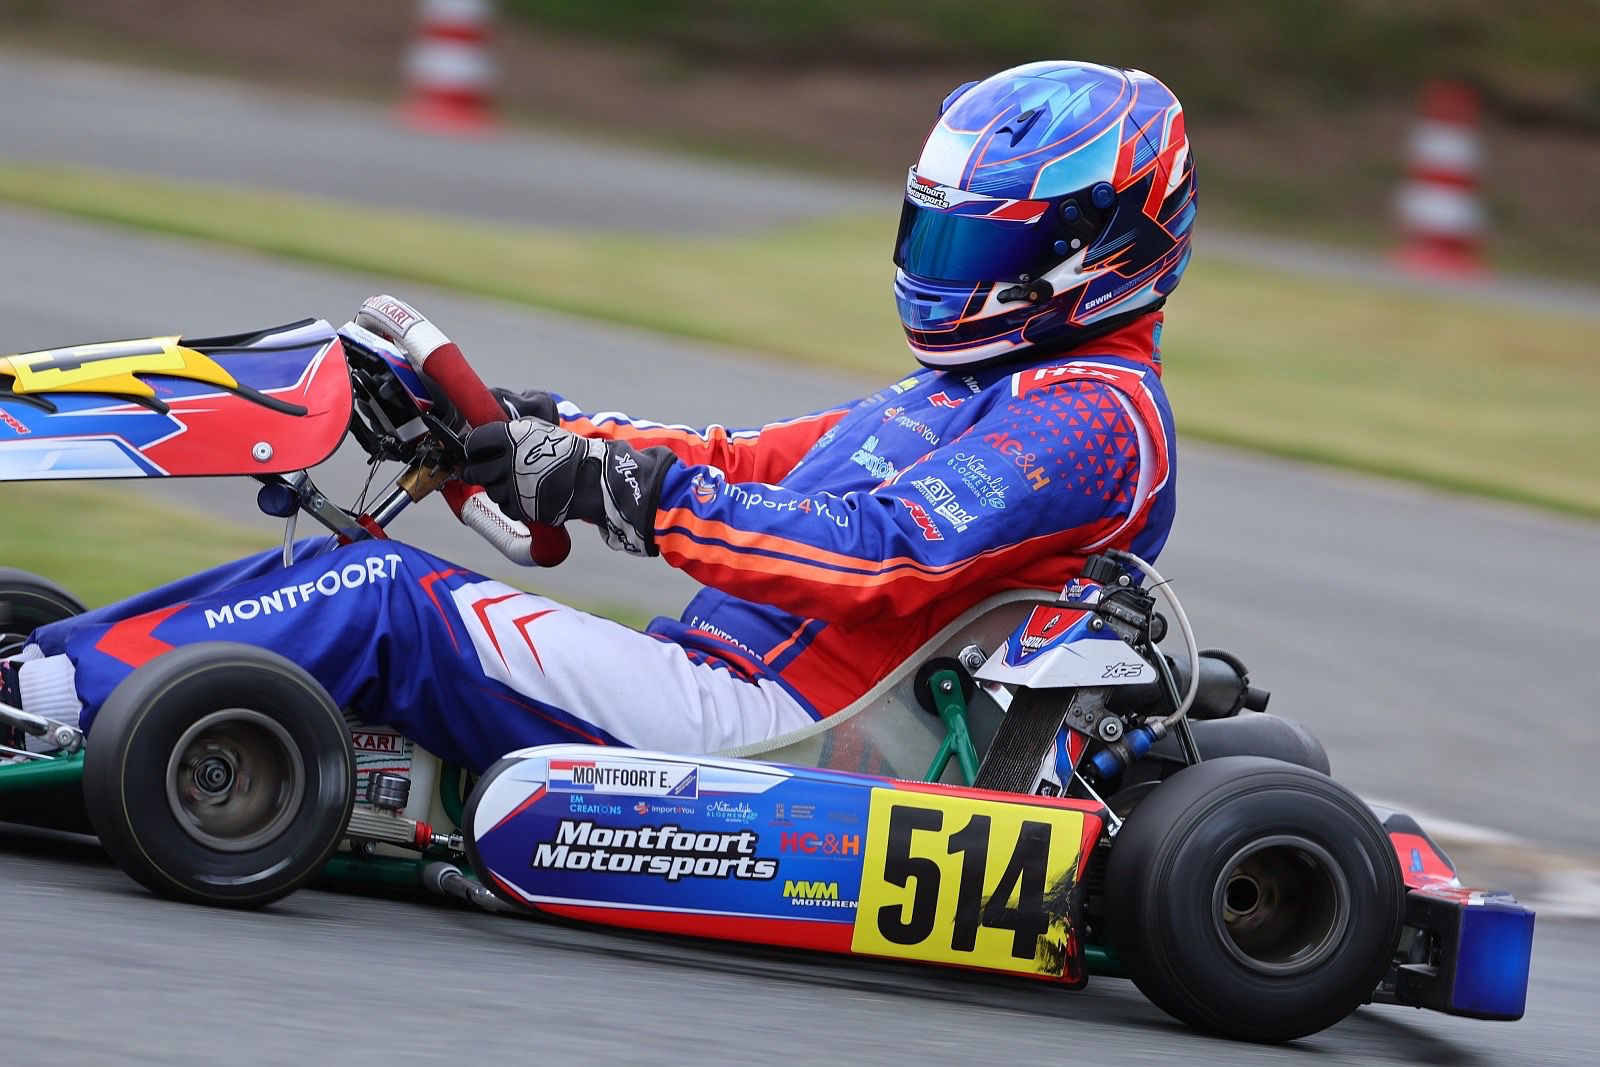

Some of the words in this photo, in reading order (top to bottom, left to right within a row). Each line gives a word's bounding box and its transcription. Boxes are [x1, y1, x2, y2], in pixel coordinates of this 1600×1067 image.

[1085, 292, 1113, 310] ERWIN
[381, 302, 411, 326] KART
[947, 459, 989, 493] BLOEMEN
[723, 482, 849, 528] Import4You
[205, 553, 403, 629] MONTFOORT
[699, 620, 763, 661] MONTFO
[1101, 662, 1144, 679] XPS
[351, 734, 397, 750] KART
[573, 766, 657, 788] MONTFOORT
[659, 771, 672, 789] E.
[569, 803, 622, 815] CREATIONS
[570, 794, 584, 803] EM
[555, 820, 757, 854] Montfoort
[532, 843, 778, 880] Motorsports
[782, 880, 839, 900] MVM
[877, 804, 1053, 960] 514
[791, 898, 858, 909] MOTOREN
